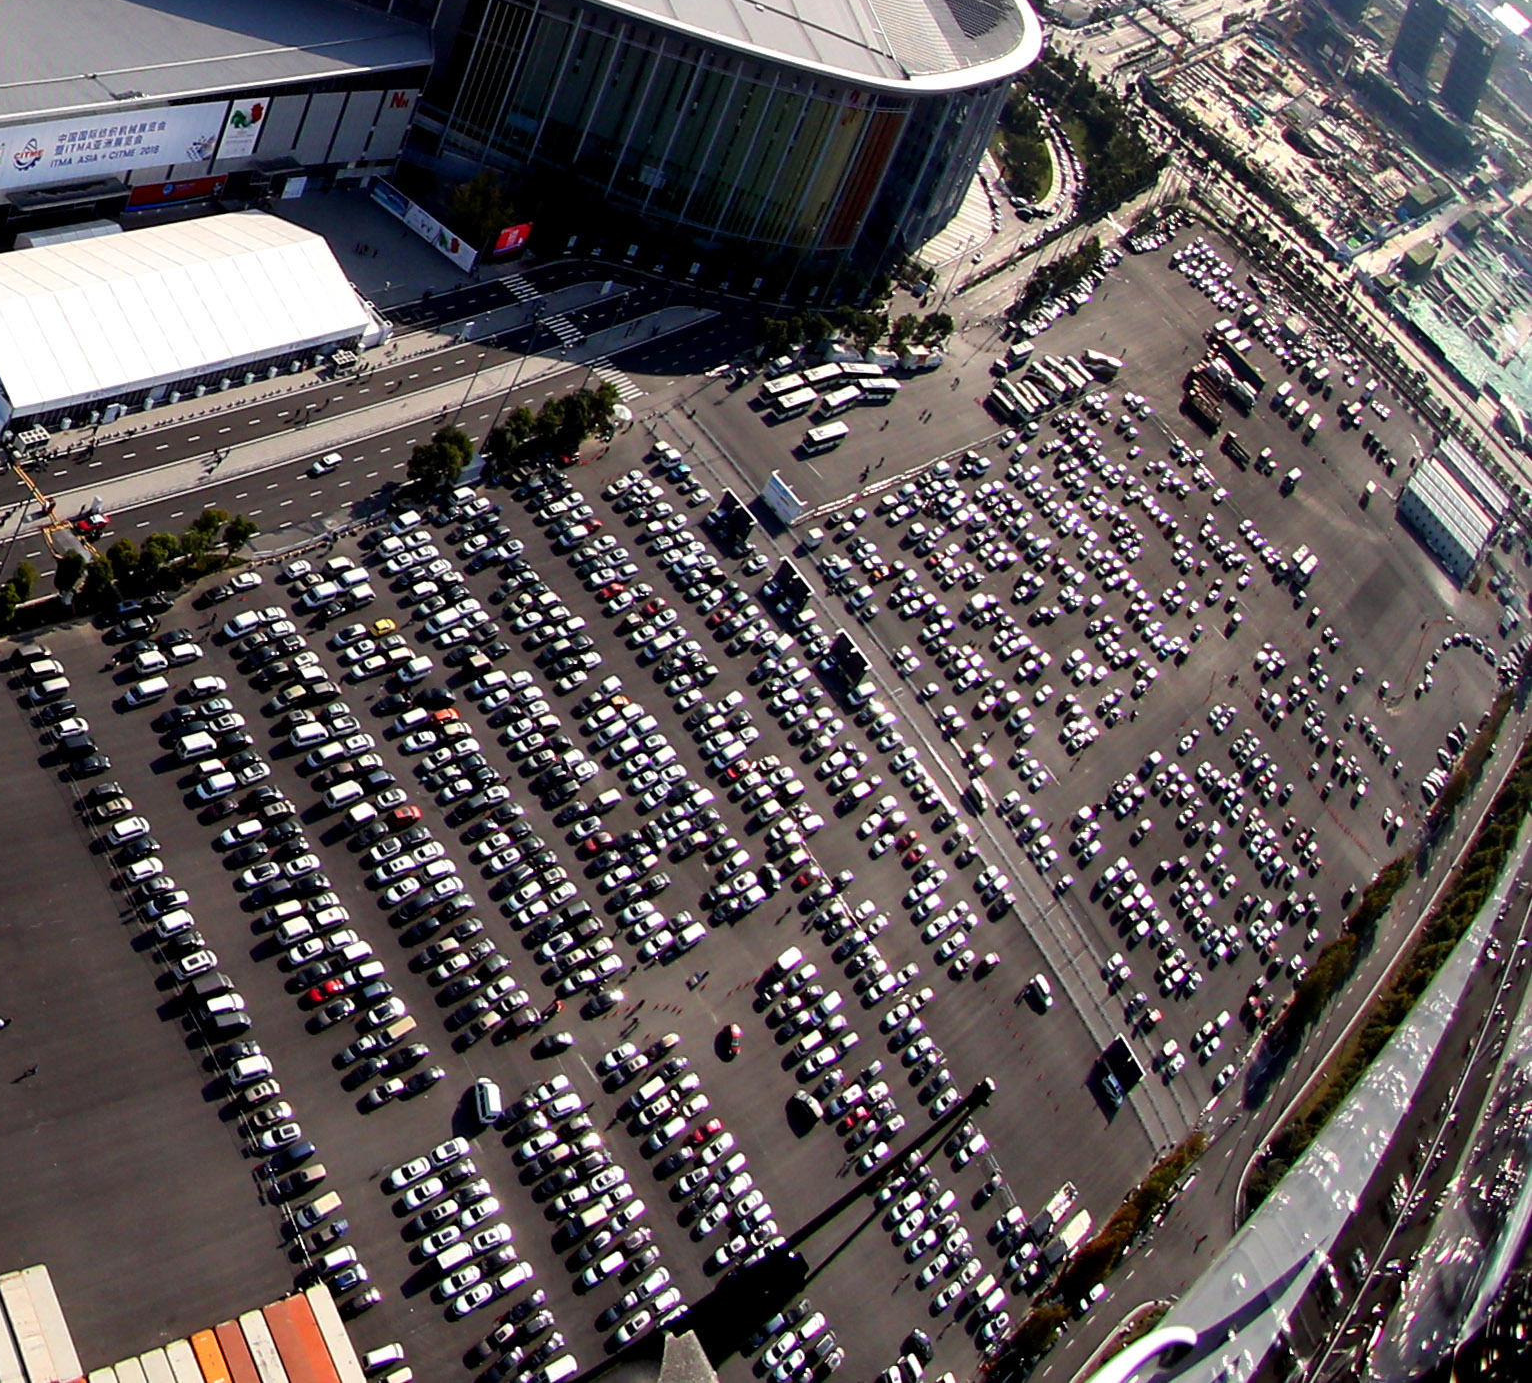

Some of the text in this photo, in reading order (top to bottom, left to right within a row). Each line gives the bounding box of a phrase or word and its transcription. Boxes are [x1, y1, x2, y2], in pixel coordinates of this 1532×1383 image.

[50, 158, 72, 168] ITMA
[77, 154, 98, 165] ASIA
[109, 149, 136, 160] CITME
